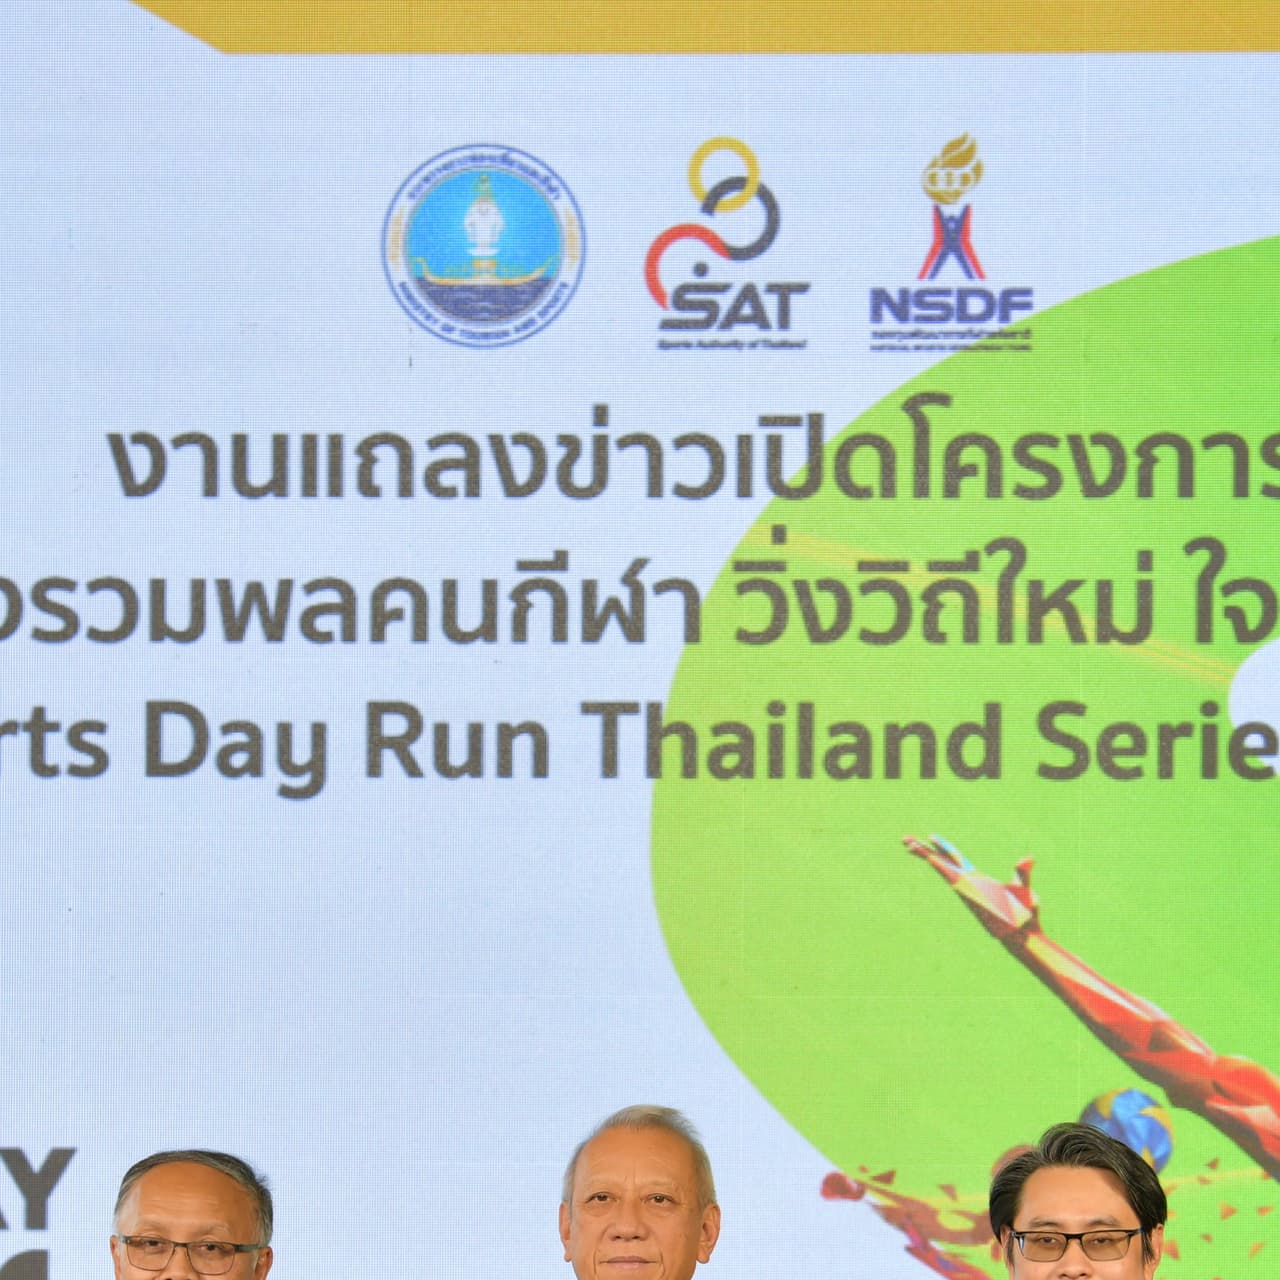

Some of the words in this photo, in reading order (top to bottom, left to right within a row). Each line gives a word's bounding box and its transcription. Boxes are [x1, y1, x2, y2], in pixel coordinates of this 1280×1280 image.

[658, 281, 811, 331] SAT
[869, 287, 1033, 324] NSDF
[732, 523, 1153, 646] วิ่งวิถีใหม่
[143, 699, 328, 802] Day
[365, 701, 550, 780] Run
[580, 700, 1002, 781] Thailand
